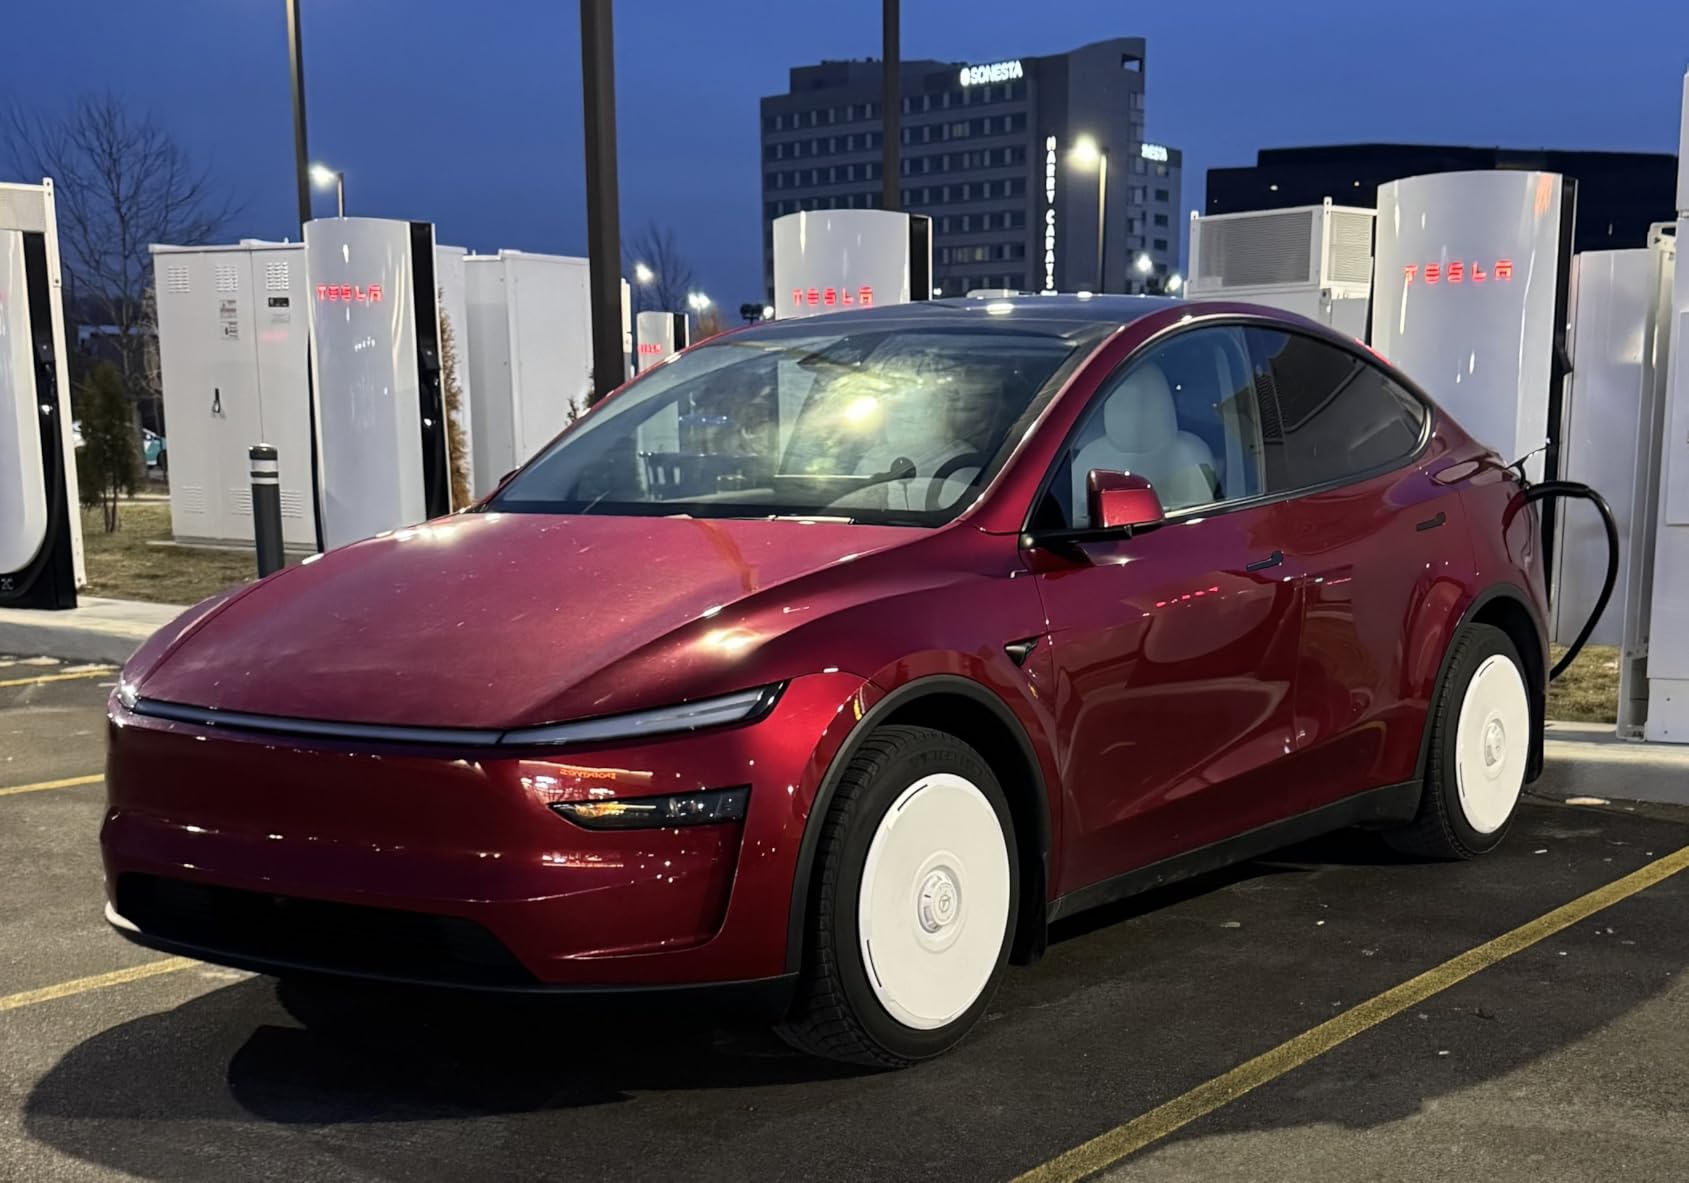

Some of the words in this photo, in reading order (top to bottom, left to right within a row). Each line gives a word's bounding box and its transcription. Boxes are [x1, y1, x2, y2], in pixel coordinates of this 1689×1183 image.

[971, 60, 1024, 85] SONESTA
[1403, 259, 1513, 286] TESLA
[315, 284, 383, 303] TESLA
[792, 285, 874, 308] TESLA
